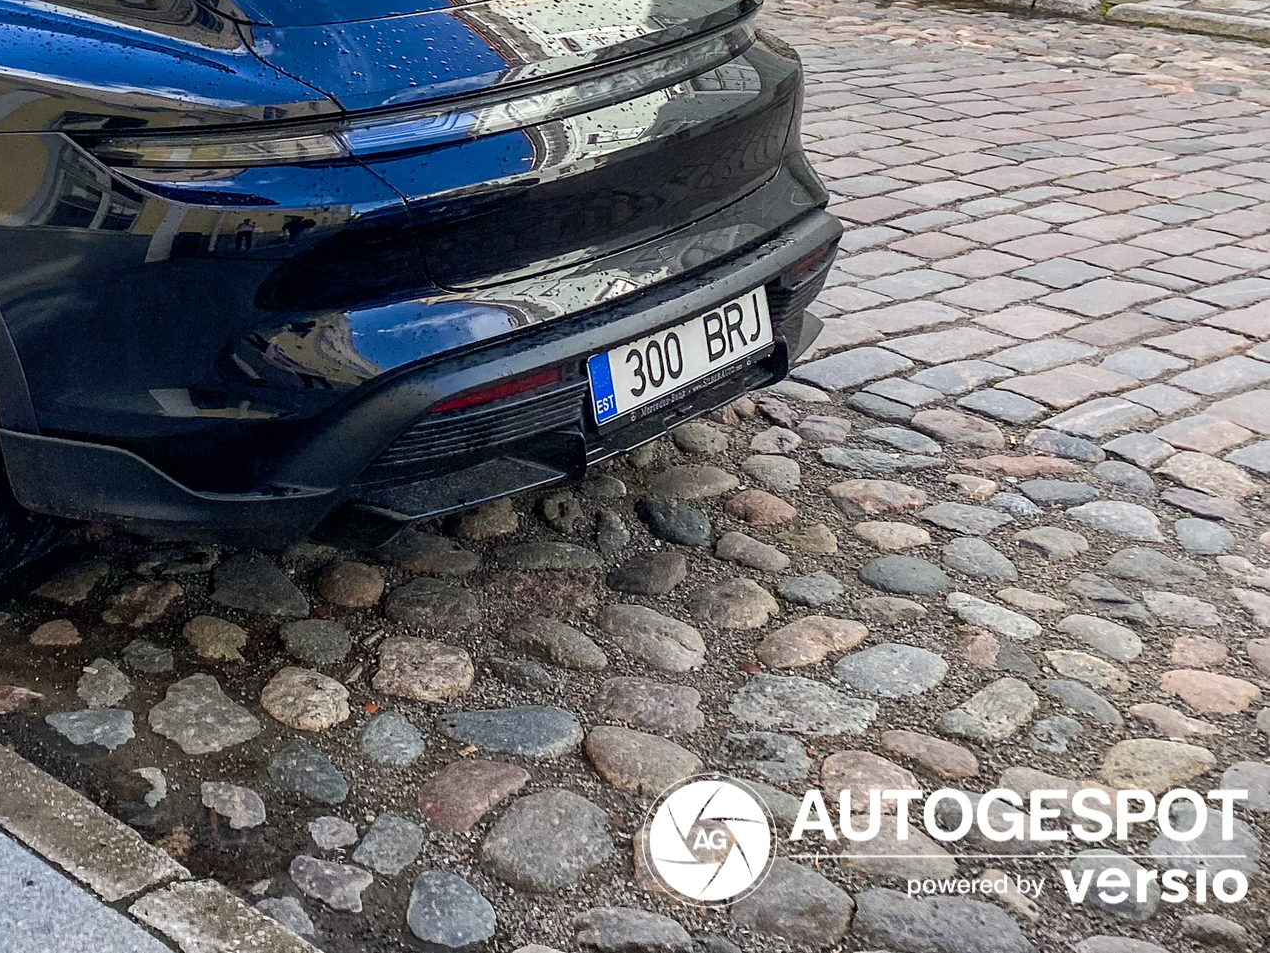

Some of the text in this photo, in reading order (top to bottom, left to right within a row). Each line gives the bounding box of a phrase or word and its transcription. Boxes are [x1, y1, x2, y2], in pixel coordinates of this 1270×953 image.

[625, 293, 762, 398] 300 BRJ
[596, 394, 614, 415] EST
